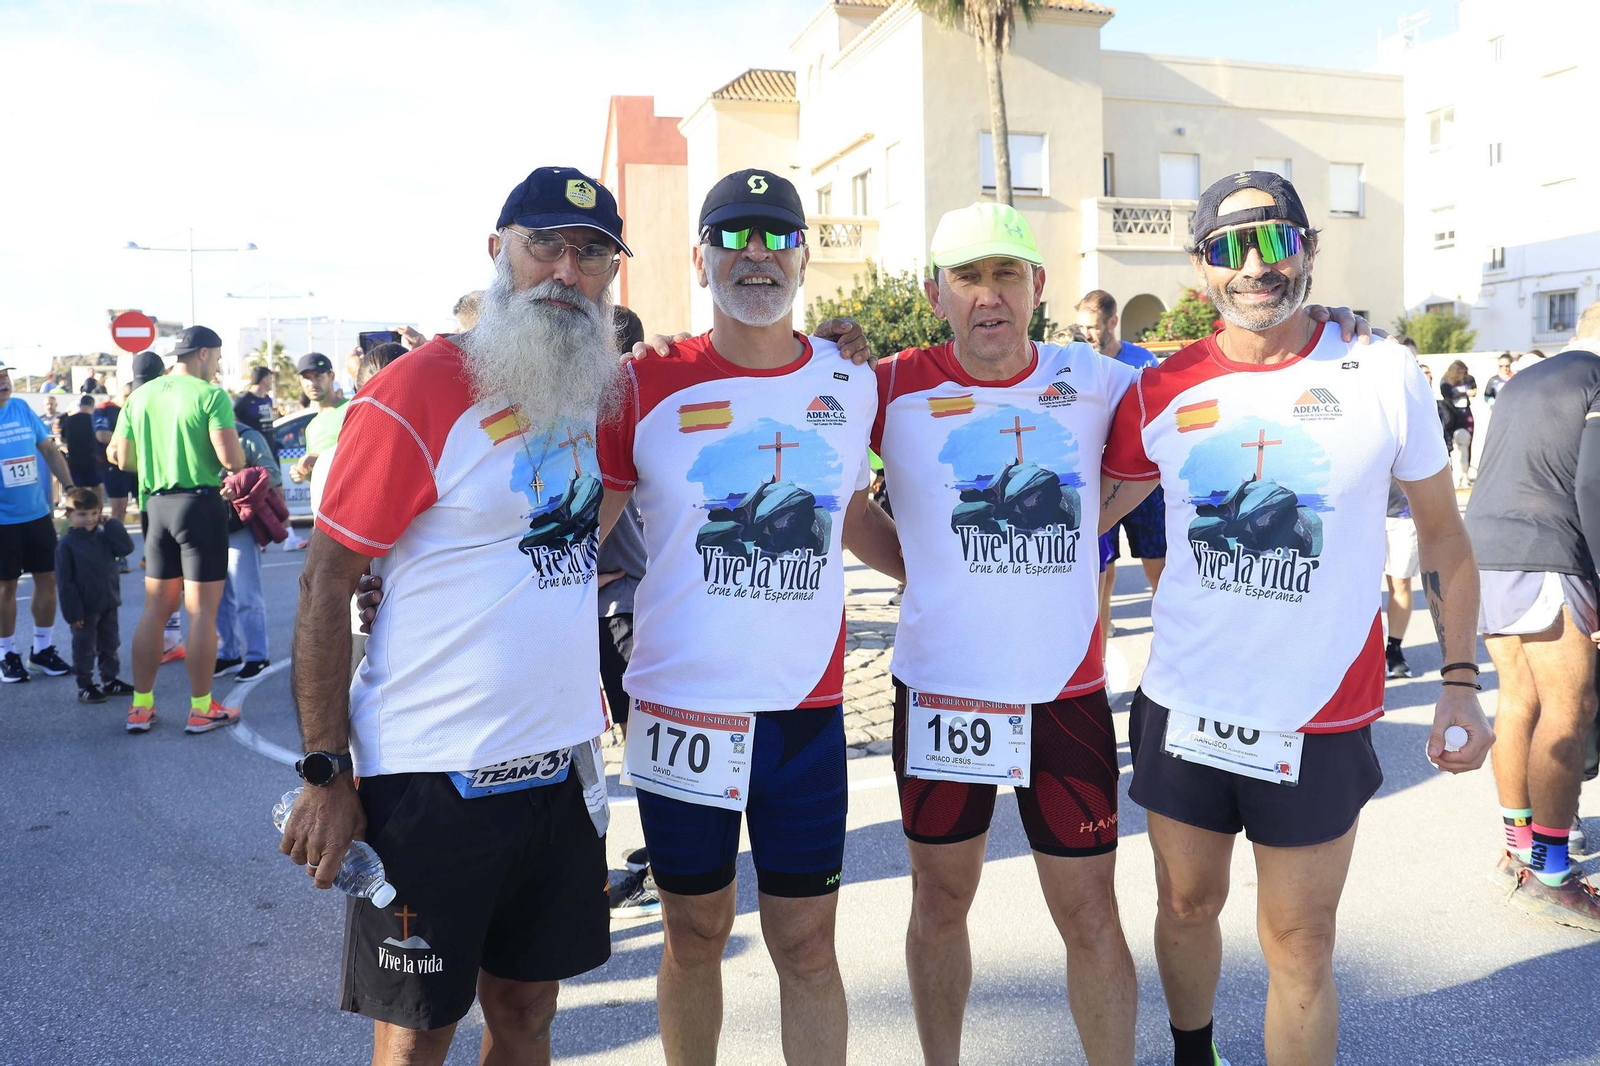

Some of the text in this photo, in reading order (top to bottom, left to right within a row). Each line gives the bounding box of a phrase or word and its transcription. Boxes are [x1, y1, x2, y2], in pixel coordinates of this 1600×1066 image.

[806, 411, 846, 419] ADEM-C.G.
[1293, 405, 1342, 414] ADEM-C.G.
[9, 463, 31, 478] 131
[958, 526, 1002, 562] Vive
[1008, 526, 1029, 564] la
[702, 547, 745, 586] Vive
[749, 549, 771, 588] la
[969, 562, 1072, 576] Cruz de la Esperanza
[1193, 541, 1229, 580] Vive
[1233, 545, 1254, 584] la
[562, 573, 571, 586] de
[707, 584, 814, 602] Cruz de la Esperanza
[1220, 580, 1231, 592] de
[1245, 585, 1303, 603] Esperanza
[685, 712, 700, 722] DEL
[703, 715, 748, 727] ESTRECHO
[928, 714, 991, 756] 169
[1190, 733, 1228, 750] FRANCISCO
[647, 722, 710, 773] 170
[1284, 740, 1292, 748] M
[926, 753, 950, 763] CIRIACO
[478, 761, 540, 785] TEAM
[653, 765, 671, 776] DAVID
[378, 946, 443, 974] Vive la vida
